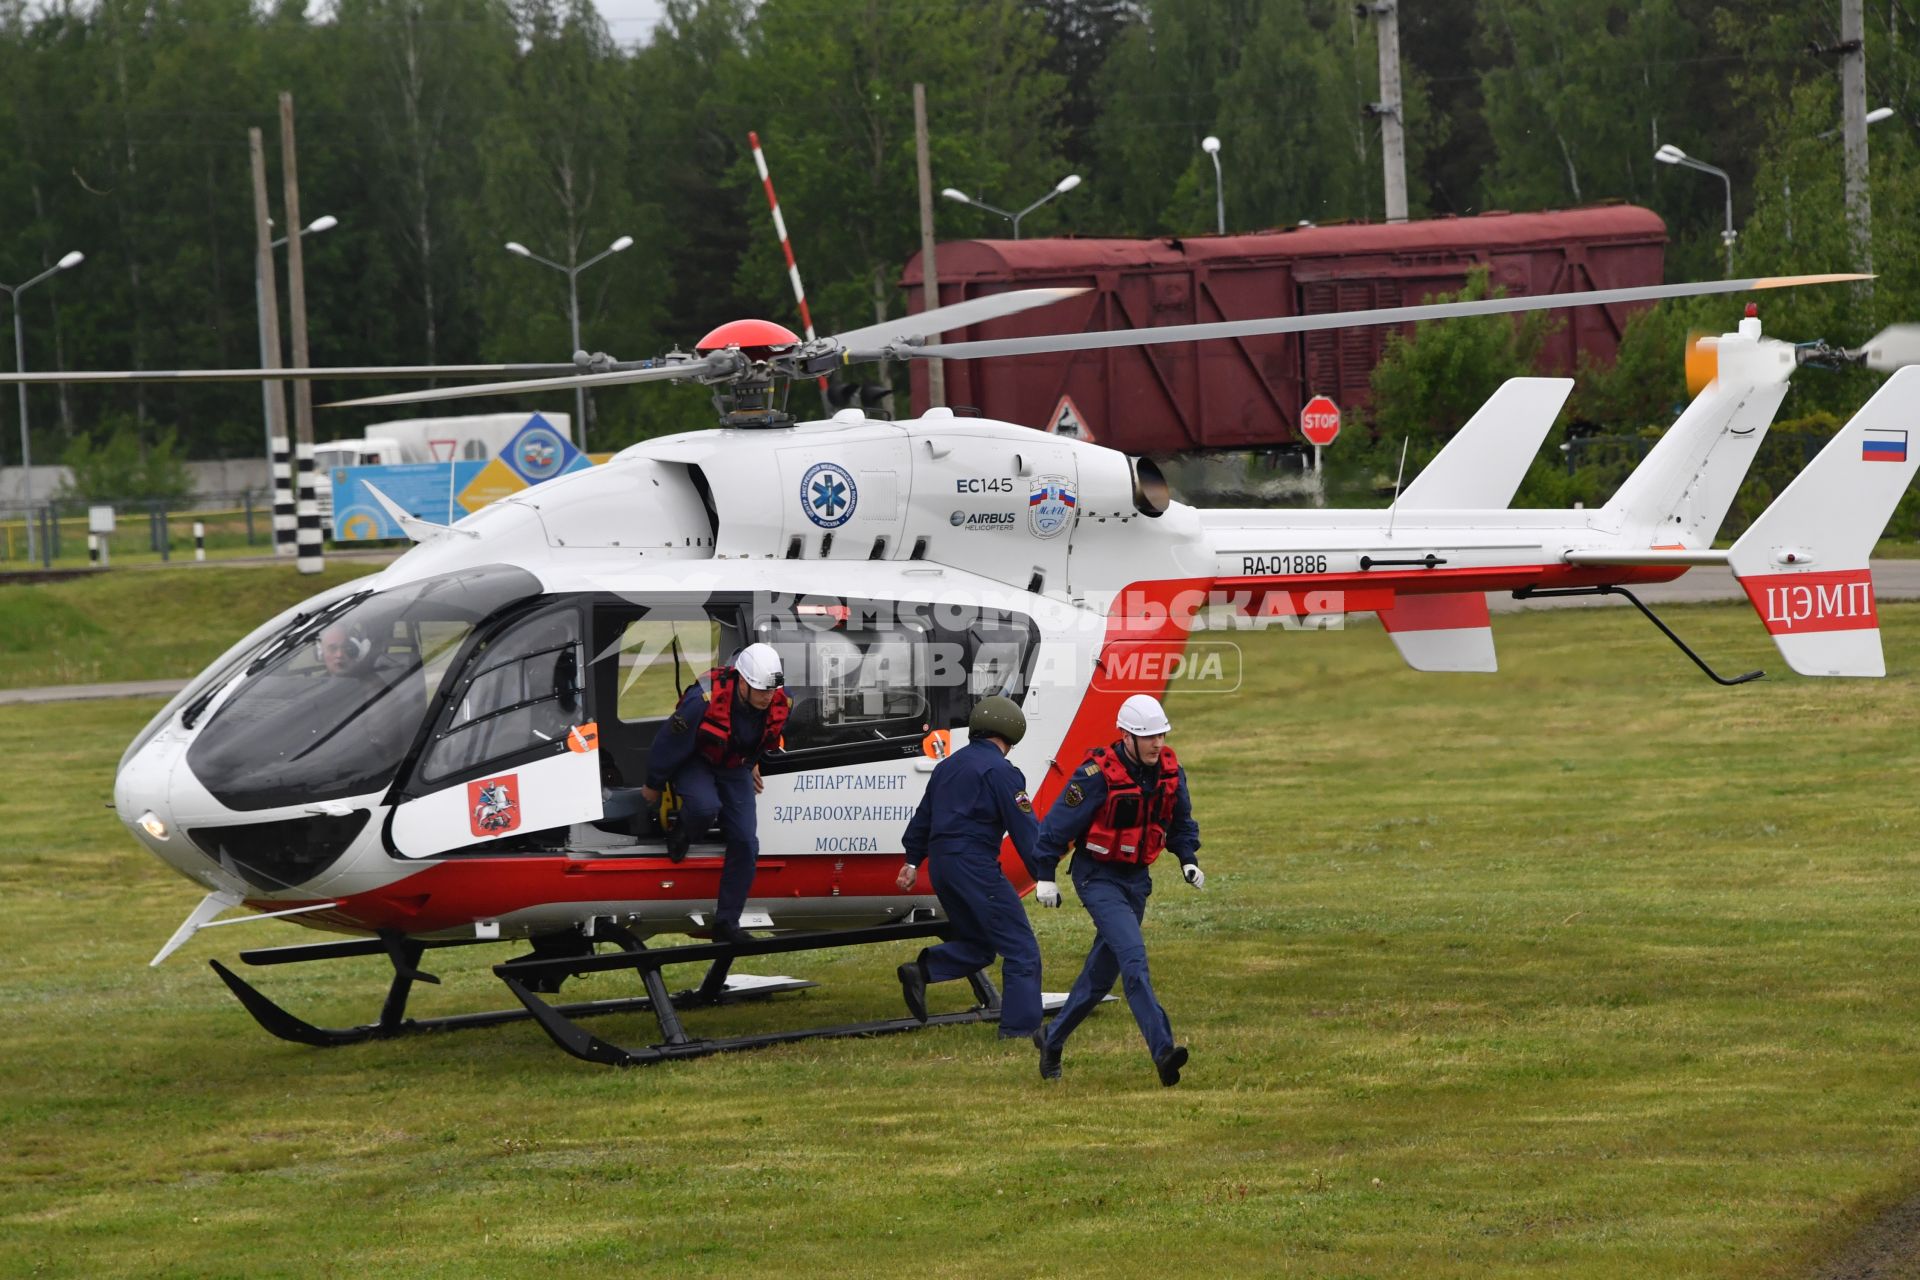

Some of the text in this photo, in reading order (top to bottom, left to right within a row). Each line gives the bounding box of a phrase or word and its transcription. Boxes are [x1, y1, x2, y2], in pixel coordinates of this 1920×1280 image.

[1305, 413, 1337, 429] STOP
[956, 478, 1013, 493] EC145
[967, 513, 1015, 524] AIRBUS
[1243, 555, 1327, 575] RA-01886
[1766, 582, 1871, 628] ЦЭМП
[794, 775, 907, 792] ДЕПАРТАМЕНТ
[774, 806, 915, 823] ЗДРАВООХРАНЕНИ
[815, 837, 877, 851] МОСКВА
